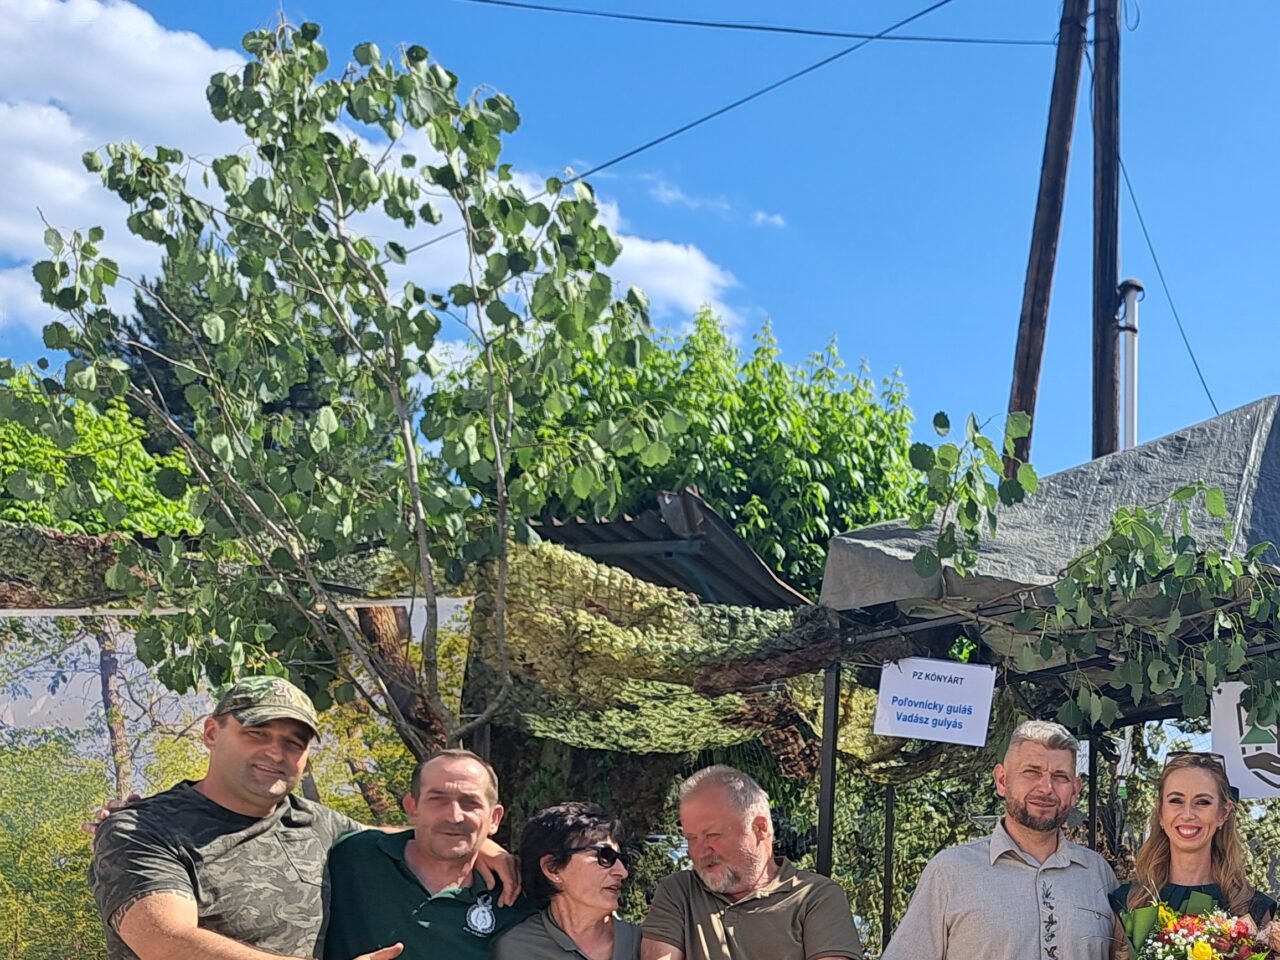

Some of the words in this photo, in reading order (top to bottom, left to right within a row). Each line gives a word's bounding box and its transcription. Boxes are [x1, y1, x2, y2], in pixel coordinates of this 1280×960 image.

[912, 670, 924, 681] PZ
[924, 671, 965, 686] KÓNYÁRT
[946, 703, 973, 715] guláš
[896, 711, 929, 725] Vadász
[931, 717, 963, 730] gulyás
